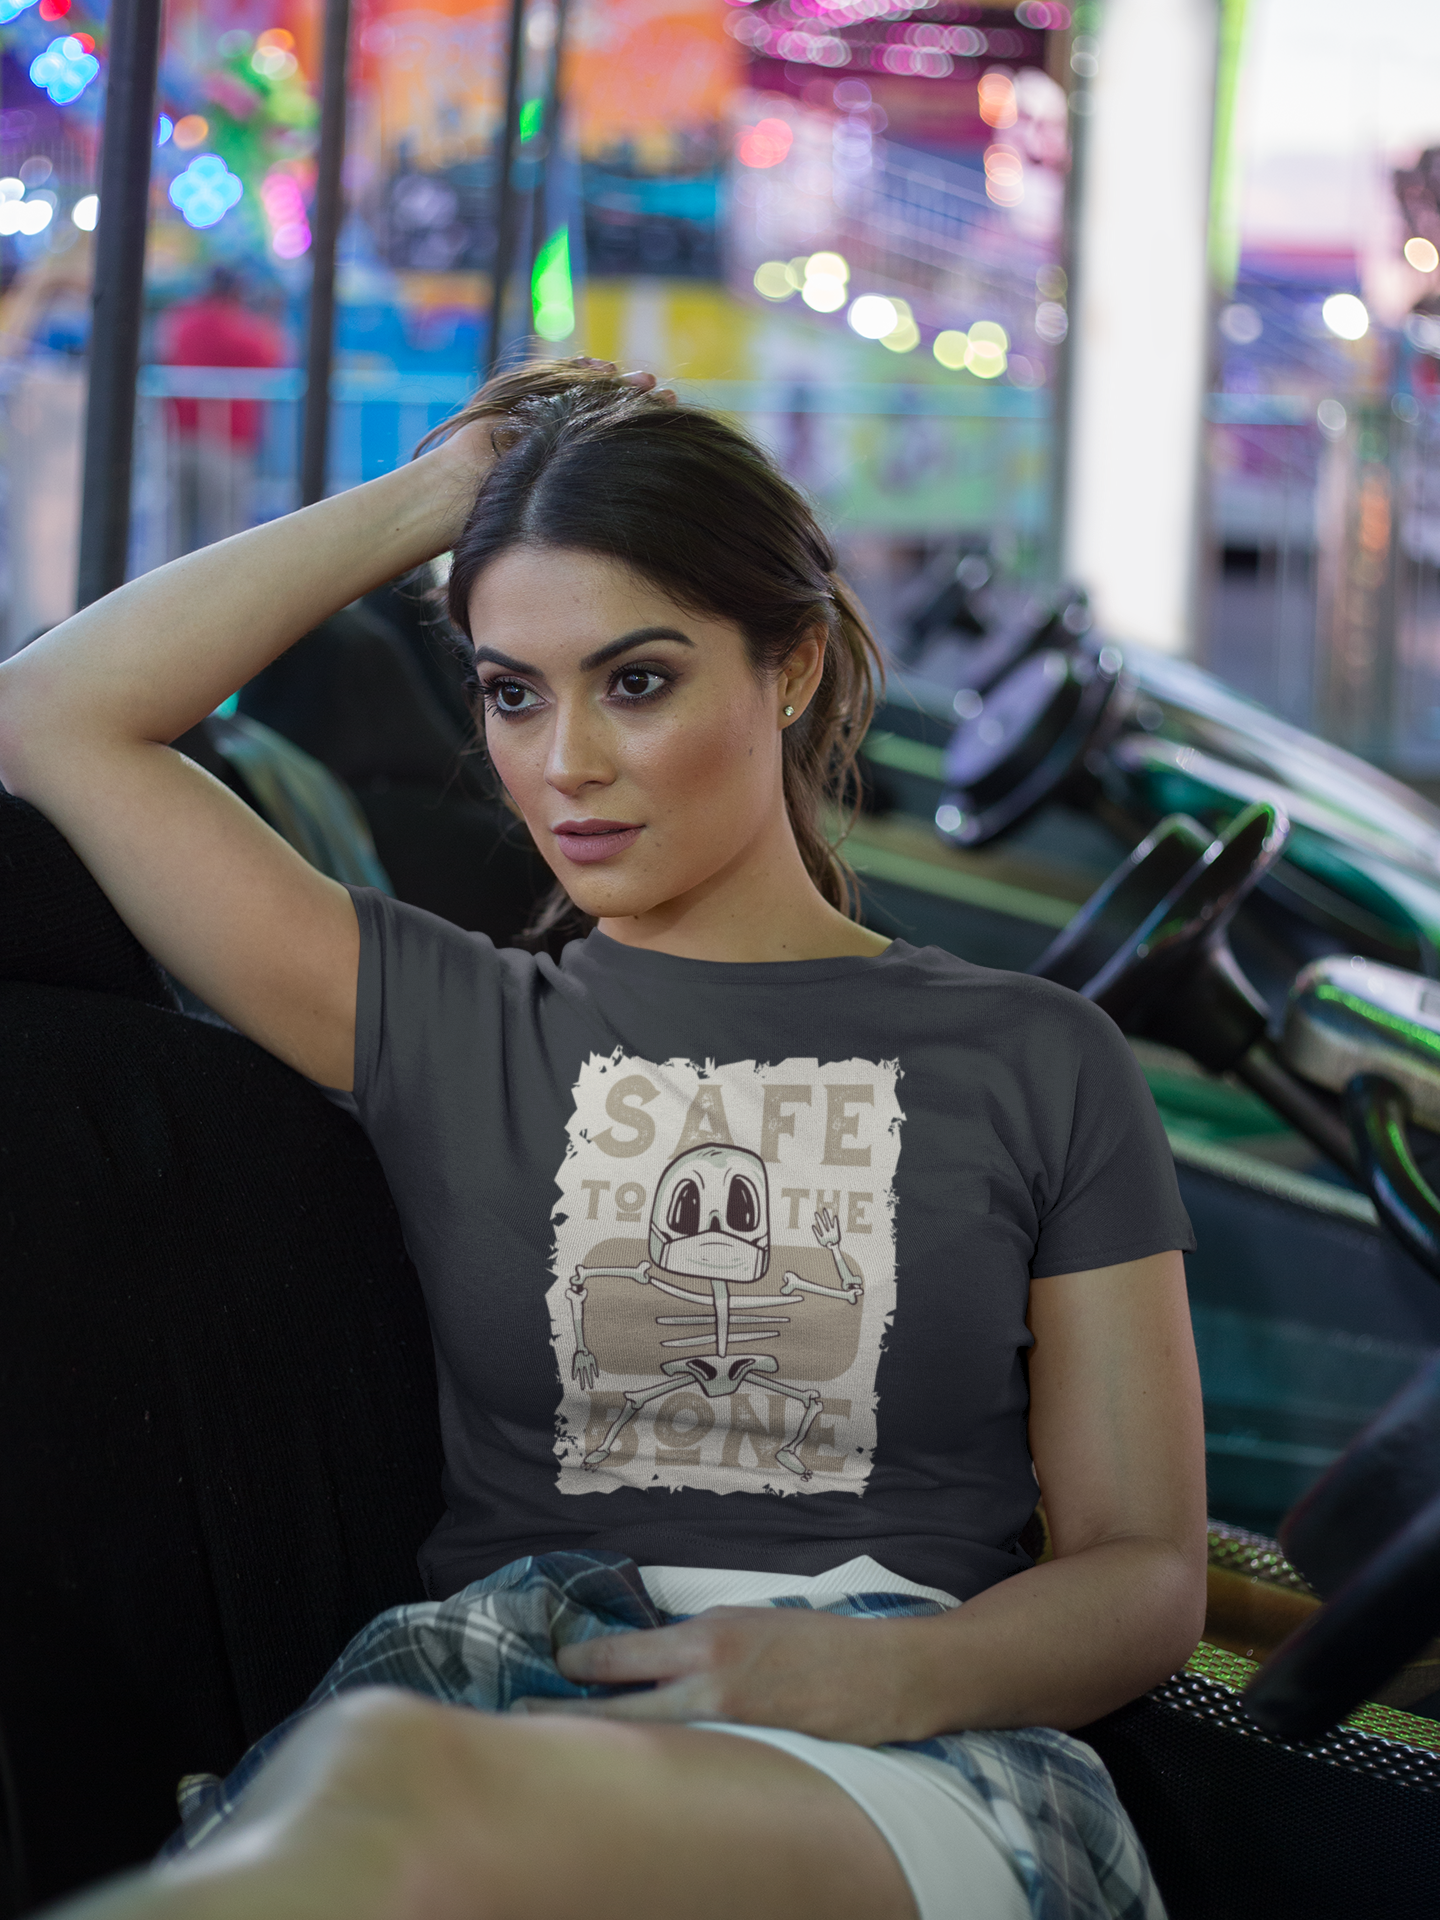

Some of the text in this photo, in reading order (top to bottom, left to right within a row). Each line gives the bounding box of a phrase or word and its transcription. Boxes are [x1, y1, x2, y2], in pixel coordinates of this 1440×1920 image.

[590, 1074, 875, 1167] SAFE
[580, 1179, 874, 1234] TO THE
[584, 1391, 852, 1473] BONE
